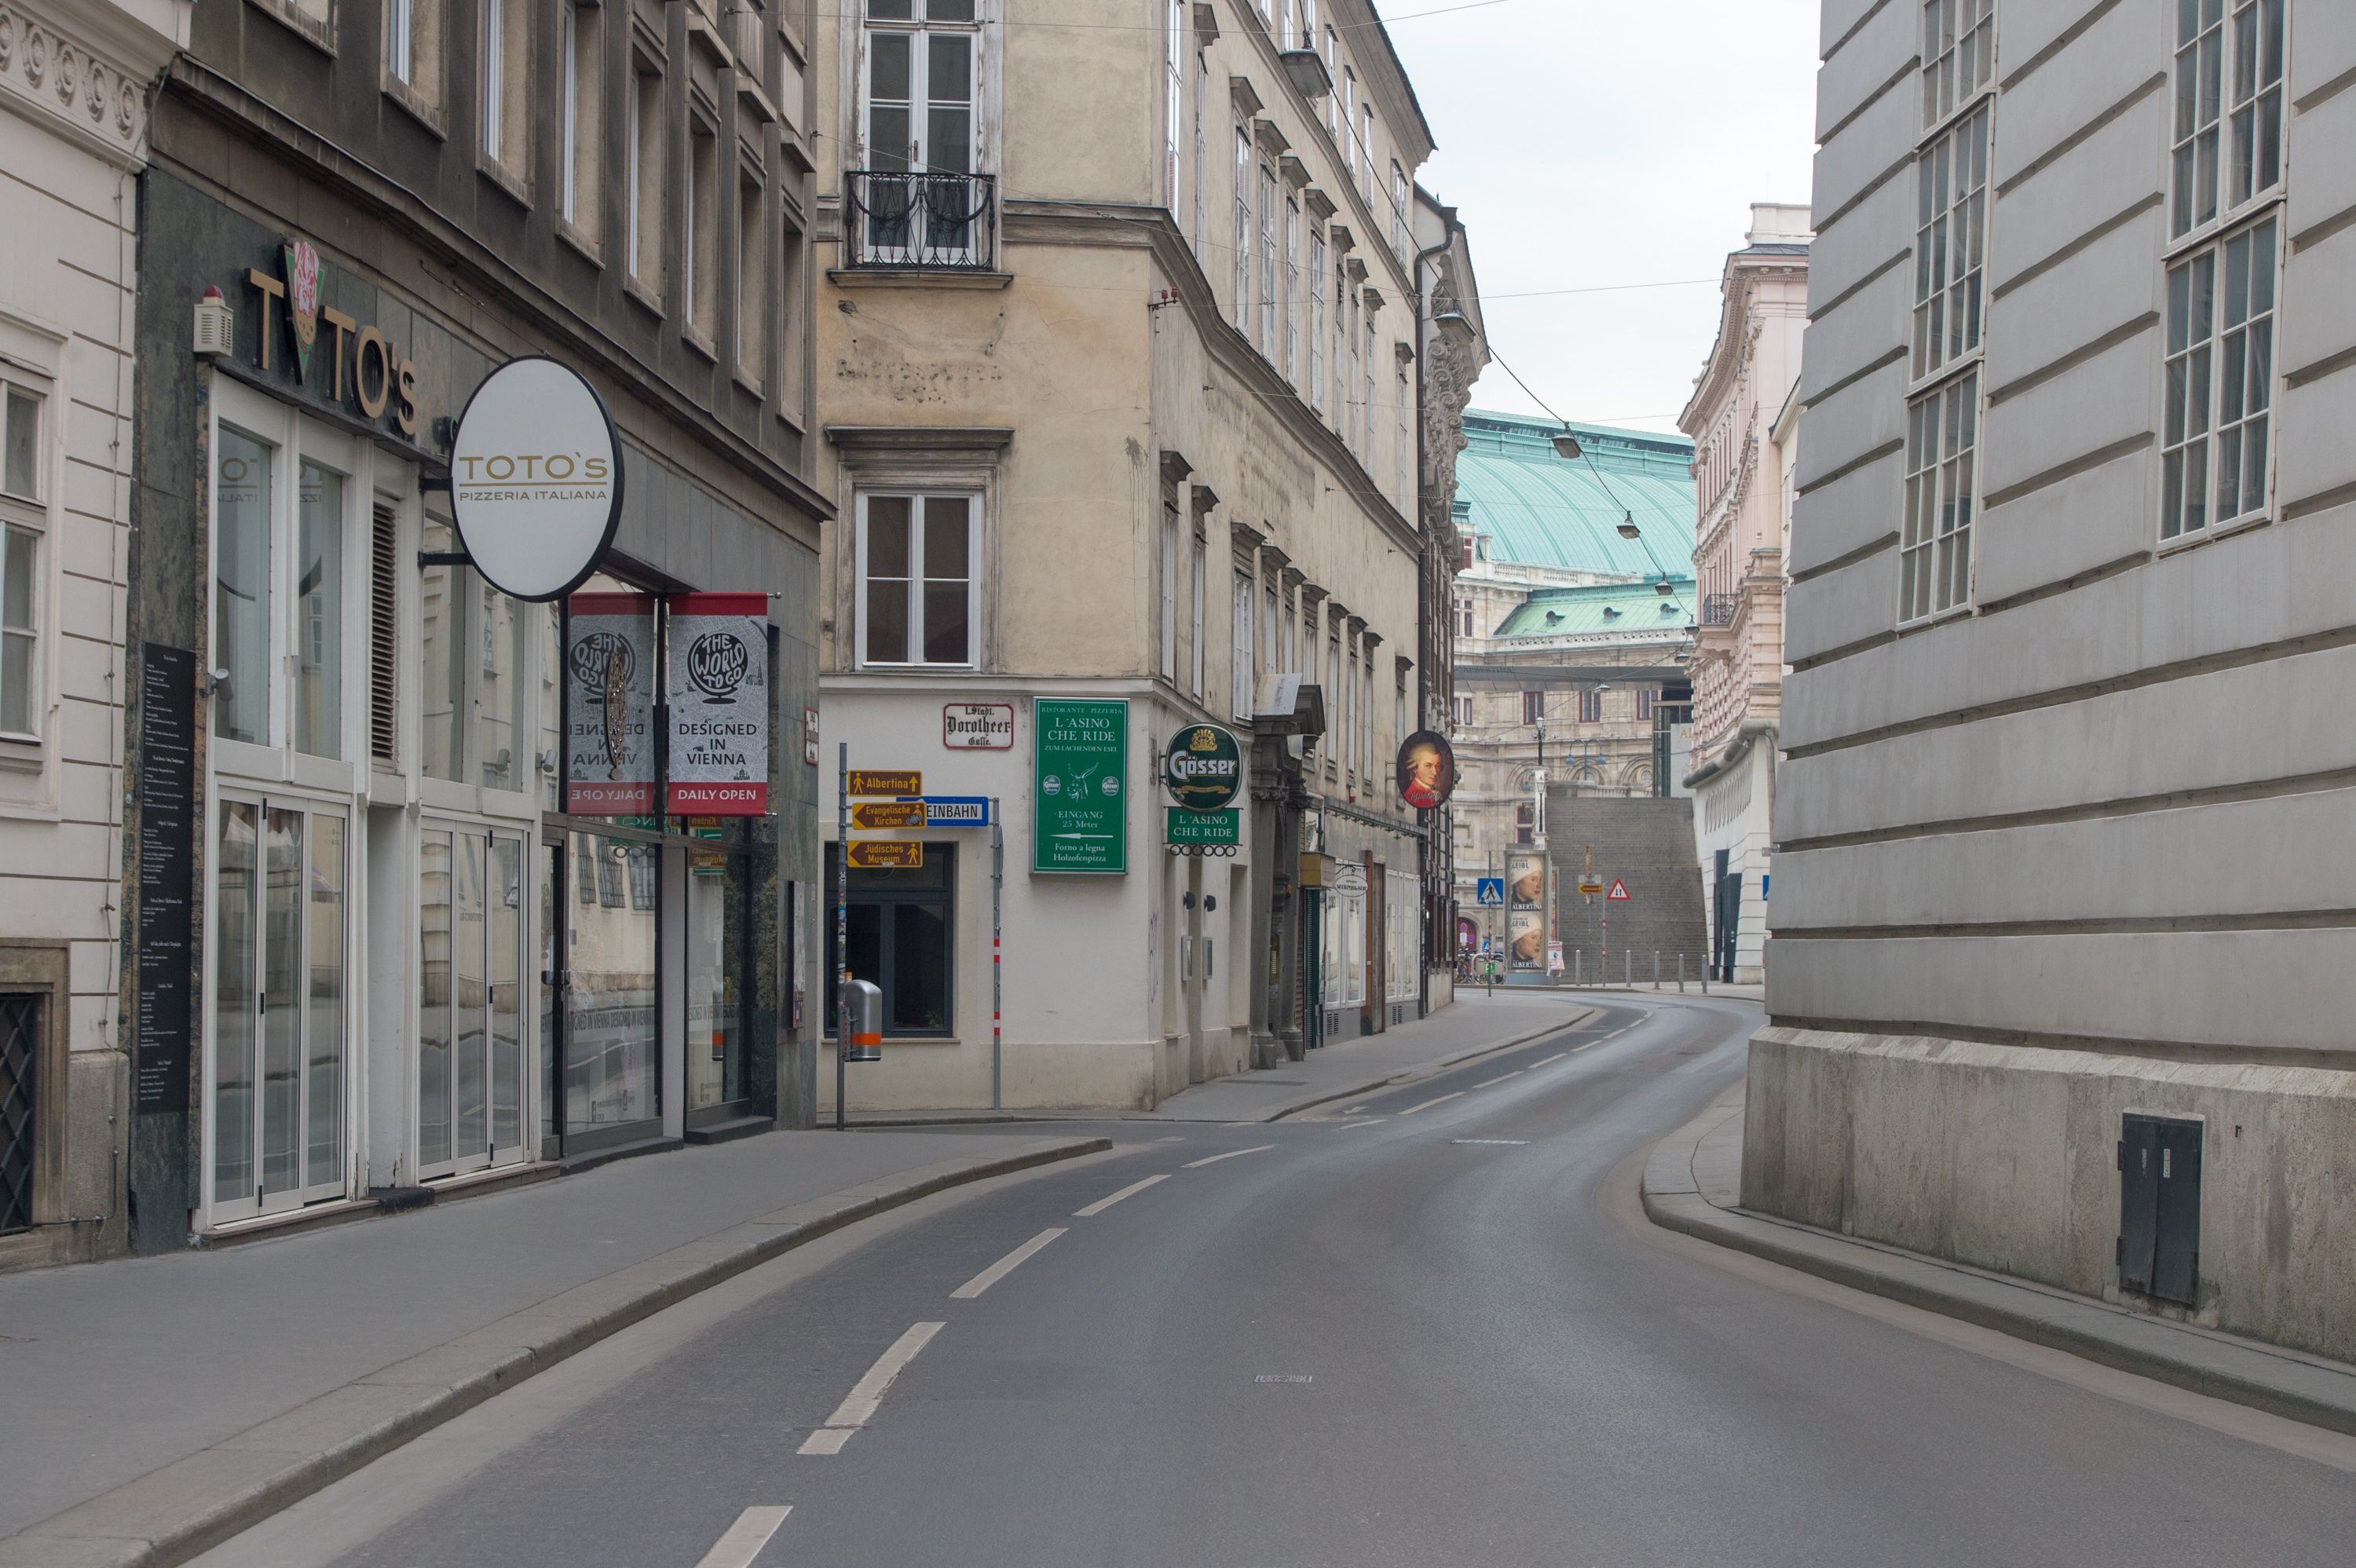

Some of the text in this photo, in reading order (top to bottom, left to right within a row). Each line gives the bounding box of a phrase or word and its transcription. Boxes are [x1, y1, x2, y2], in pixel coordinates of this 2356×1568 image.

[460, 491, 606, 502] PIZZERIA ITALIANA
[701, 634, 732, 653] THE
[694, 642, 744, 675] WORLD
[703, 667, 742, 688] TO GO
[679, 723, 757, 736] DESIGNED
[1048, 731, 1115, 741] CHE RIDE
[710, 739, 726, 751] IN
[686, 753, 746, 766] VIENNA
[1170, 750, 1236, 781] Gösser
[866, 777, 909, 789] Albertina
[678, 790, 756, 800] DAILY OPEN
[866, 806, 911, 817] Evangelische
[927, 805, 978, 817] EINBAHN
[1058, 811, 1103, 820] EINGANG
[874, 817, 902, 826] Kirchen
[1173, 827, 1233, 837] CHE RIDE
[865, 844, 904, 853] Jüdisches
[1055, 842, 1077, 851] Forno
[1085, 842, 1105, 853] legna
[868, 854, 900, 863] Museum
[1054, 853, 1106, 863] Holzofenpizza
